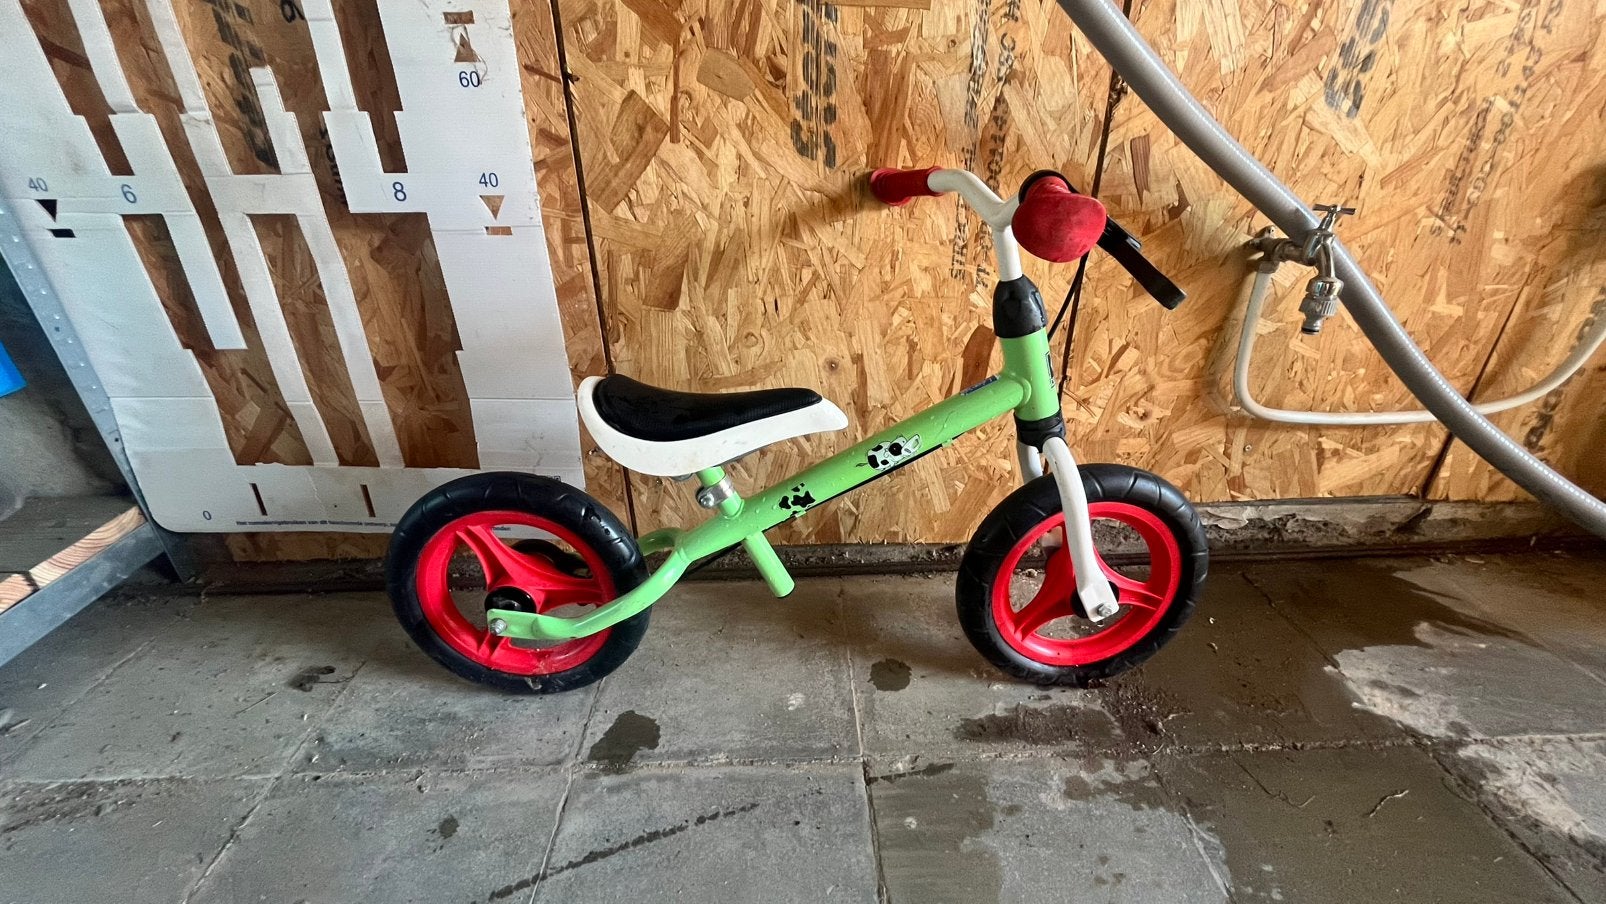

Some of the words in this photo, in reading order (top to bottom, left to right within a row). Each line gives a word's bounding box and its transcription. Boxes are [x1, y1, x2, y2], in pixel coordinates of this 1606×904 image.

[458, 70, 482, 88] 60
[28, 177, 49, 193] 40
[478, 172, 499, 188] 40
[120, 183, 138, 204] 6
[392, 181, 407, 202] 8
[202, 510, 212, 521] 0
